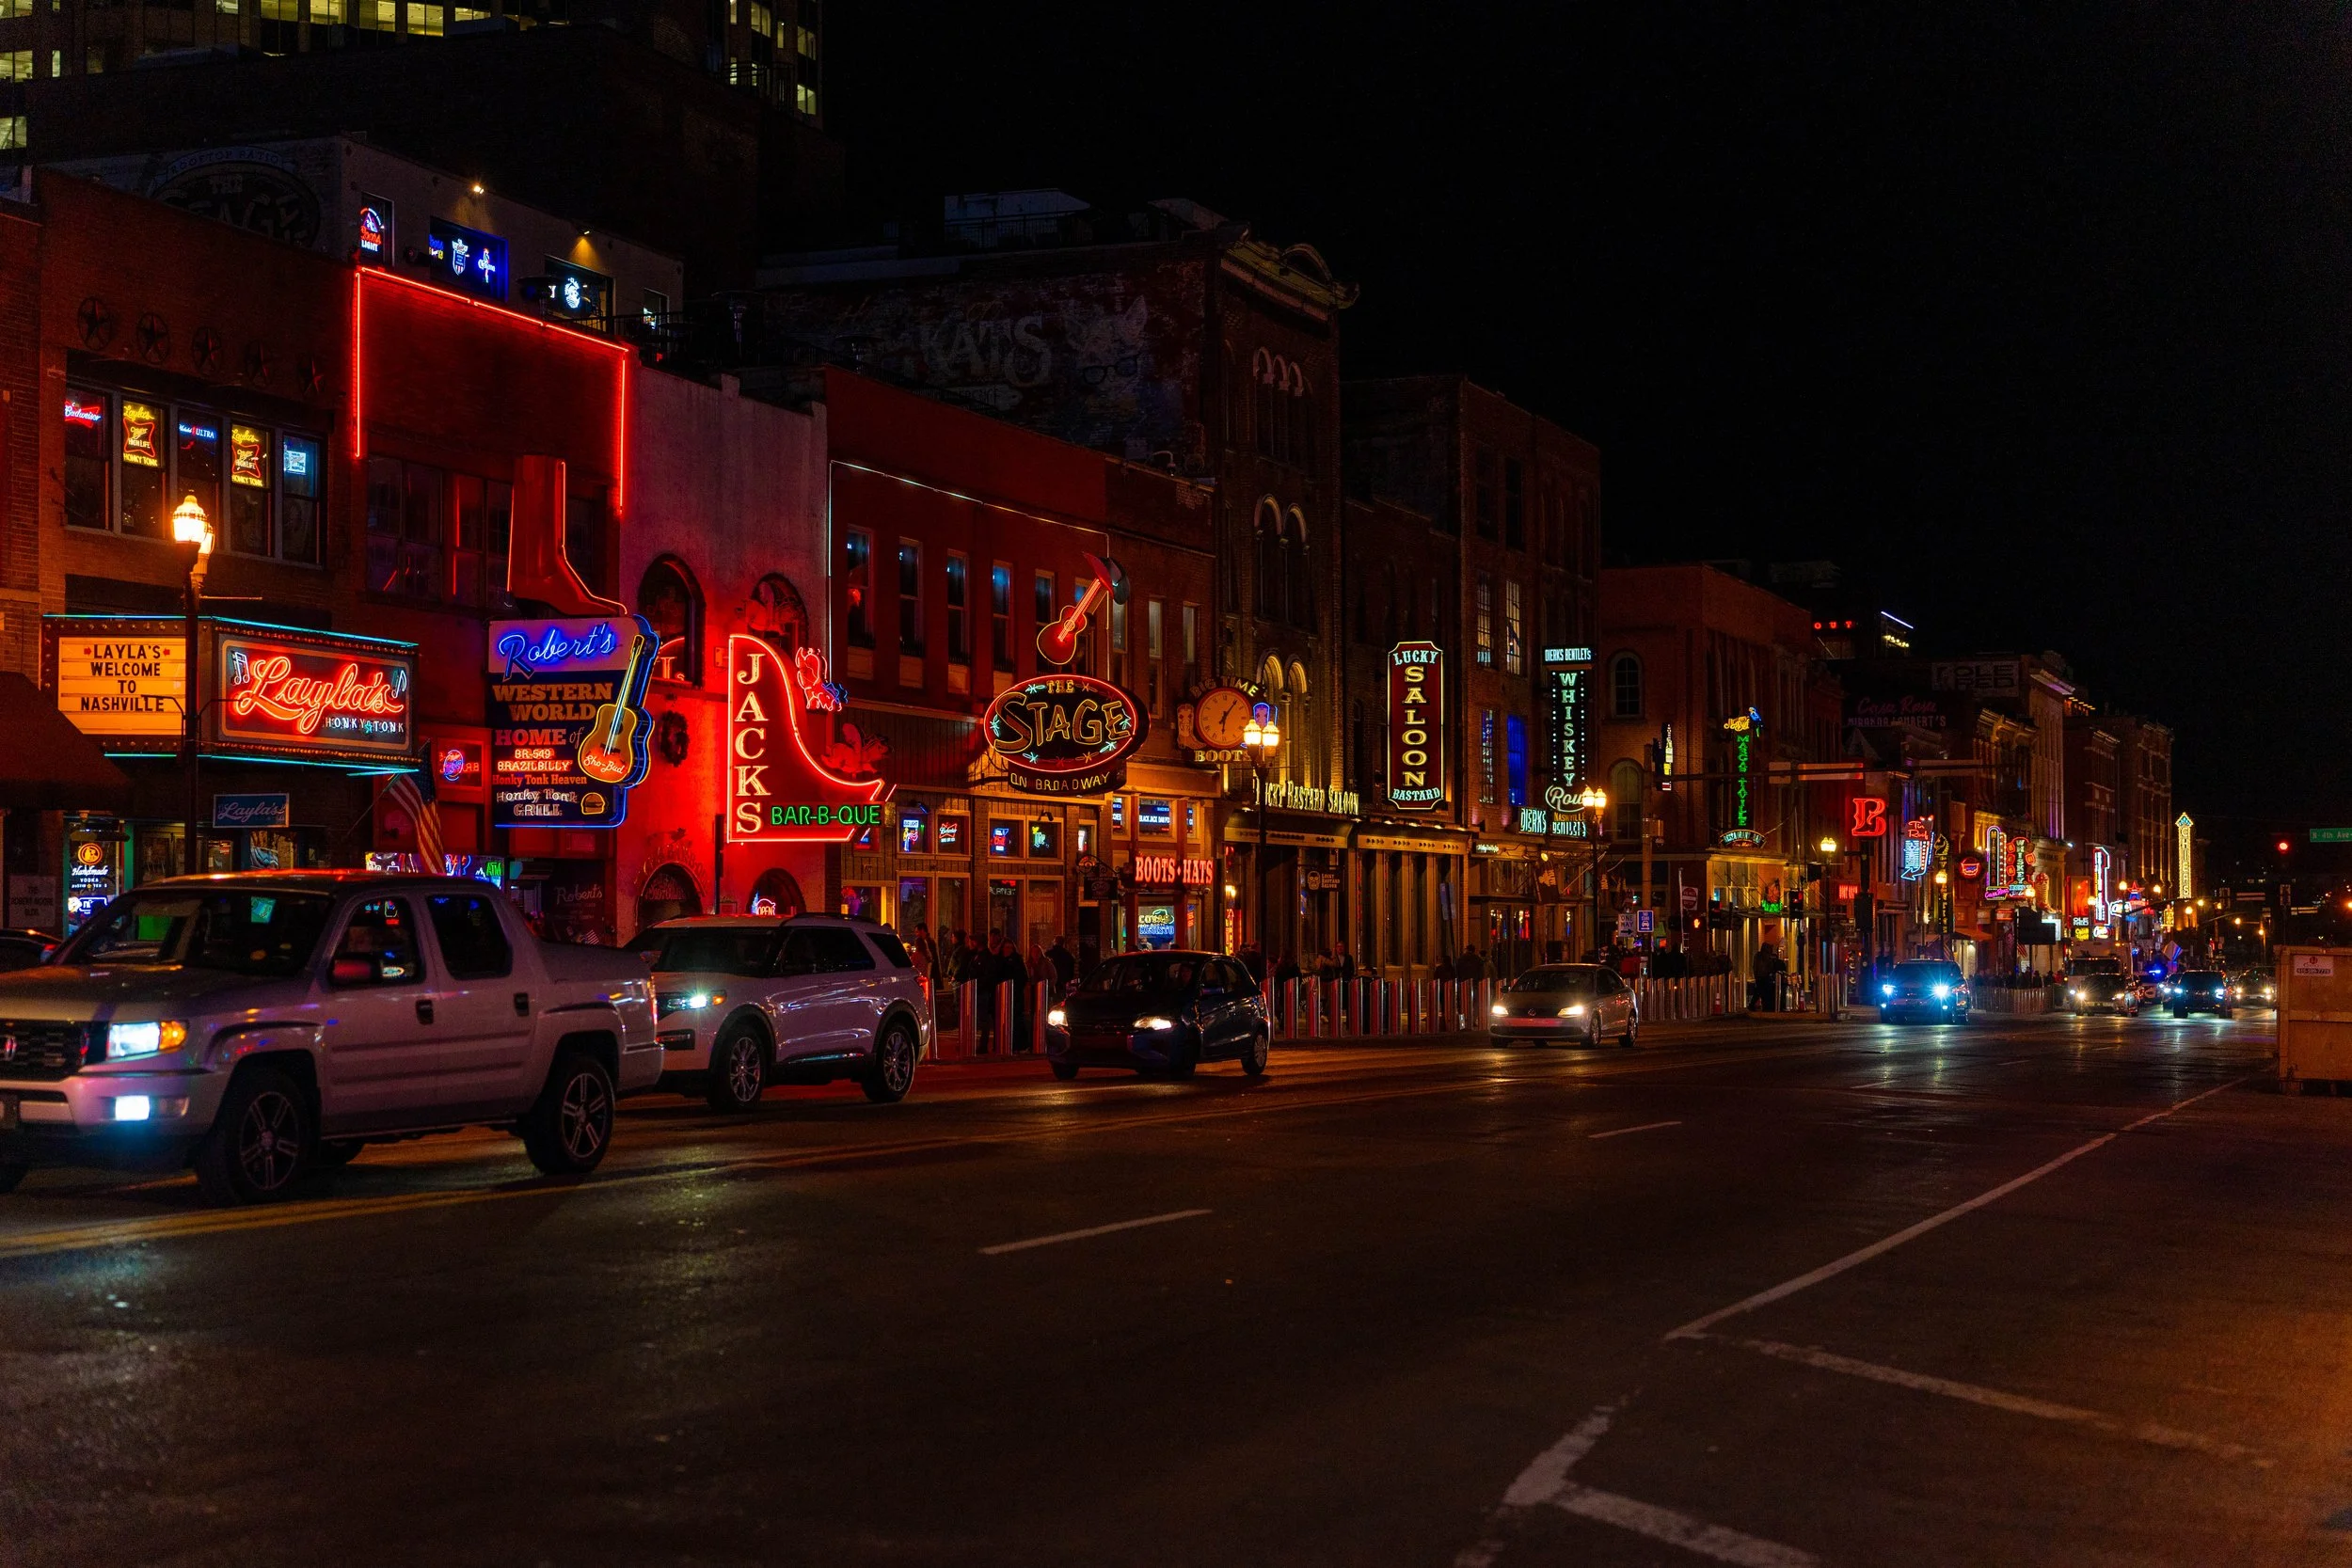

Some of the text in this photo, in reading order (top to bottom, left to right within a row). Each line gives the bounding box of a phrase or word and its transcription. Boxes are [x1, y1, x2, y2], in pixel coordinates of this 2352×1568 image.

[196, 428, 215, 439] ULTRA
[94, 644, 160, 658] LAYLA'S
[499, 624, 614, 680] Robert's
[1393, 649, 1438, 665] LUCKY
[1545, 649, 1564, 661] DIERKS
[90, 662, 160, 676] WELCOME
[118, 680, 136, 693] TO
[492, 683, 613, 702] WESTERN
[1046, 679, 1075, 694] THE
[1220, 675, 1260, 697] TIME
[236, 657, 404, 734] Layla's
[81, 697, 164, 712] NASHVILLE
[509, 705, 596, 721] WORLD
[323, 717, 404, 733] HONKY TONK
[993, 691, 1131, 753] STAGE
[1402, 666, 1427, 786] SALOON
[1559, 673, 1578, 786] WHISKEY
[495, 726, 584, 749] HOME of
[735, 654, 771, 833] JACKS
[515, 749, 554, 759] BR-549
[1194, 750, 1252, 762] BOOTS
[583, 755, 626, 774] Sho-Bud
[493, 774, 587, 787] Honky Tonk Heaven
[1010, 771, 1110, 791] ON BROADWAY
[496, 789, 578, 803] Honky Tonk
[1287, 780, 1325, 812] BASTARD
[1328, 784, 1359, 816] SALOON
[1392, 787, 1440, 801] BASTARD
[216, 801, 285, 823] Layla's
[514, 803, 563, 816] GRILL
[771, 805, 881, 825] BAR-B-QUE
[485, 862, 502, 877] ATM
[2016, 840, 2025, 883] WHISKEY
[1135, 856, 1214, 884] BOOTS HATS
